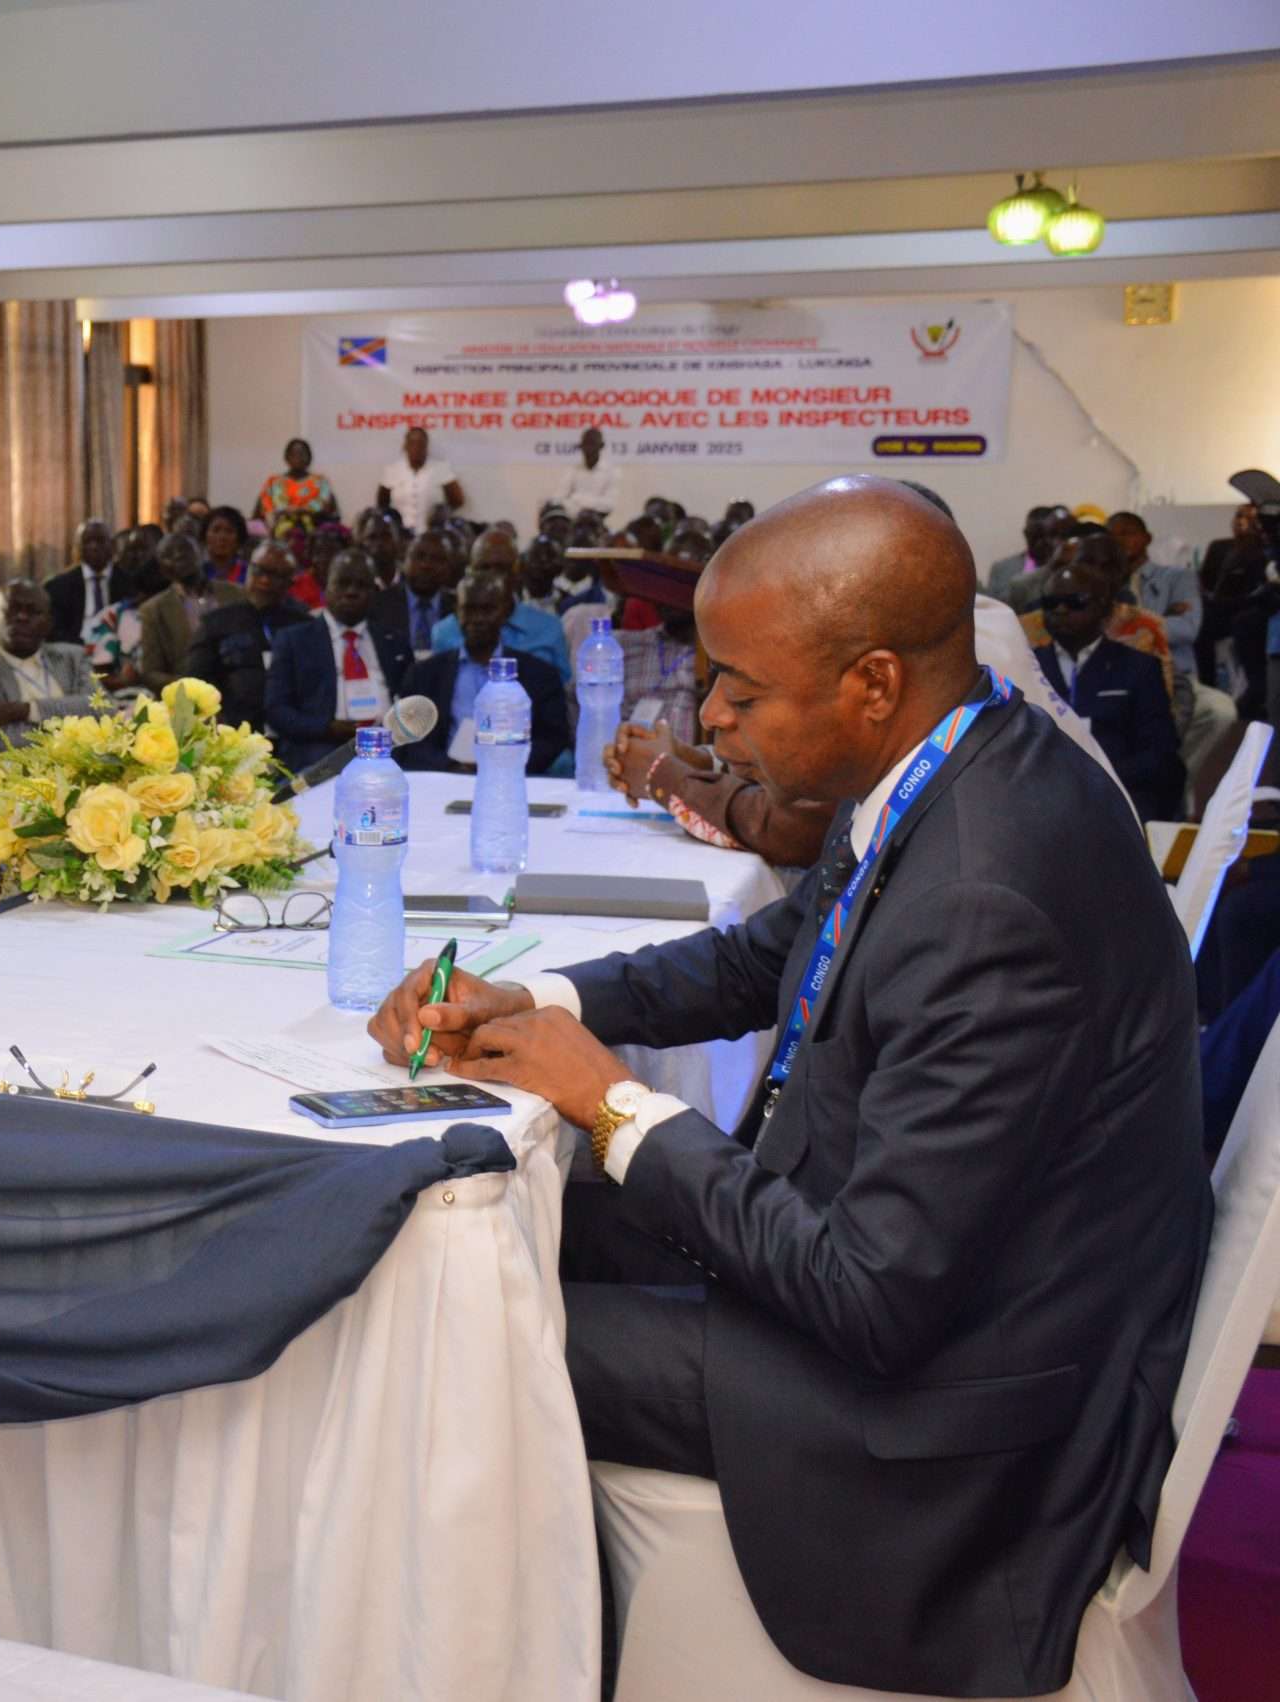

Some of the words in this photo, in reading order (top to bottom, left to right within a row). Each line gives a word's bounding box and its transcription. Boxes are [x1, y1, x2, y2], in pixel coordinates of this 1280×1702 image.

[413, 363, 494, 374] INSPECTION
[498, 362, 578, 373] PRINCIPALE
[583, 360, 677, 372] PROVINCIALE
[683, 360, 701, 371] DE
[707, 359, 782, 370] KINSHASA
[798, 357, 872, 369] LUKUNGA
[403, 391, 507, 407] MATINEE
[516, 388, 696, 406] PEDAGOGIQUE
[708, 387, 741, 405] DE
[752, 386, 891, 404] MONSIEUR
[337, 410, 502, 430] L'INSPECTEUR
[512, 411, 631, 429] GENERAL
[640, 410, 708, 428] AVEC
[719, 410, 769, 428] LES
[779, 408, 970, 427] INSPECTEURS
[636, 441, 698, 455] JANVIER
[898, 759, 932, 799] CONGO
[847, 859, 869, 897] CONGO
[810, 955, 832, 991] CONGO
